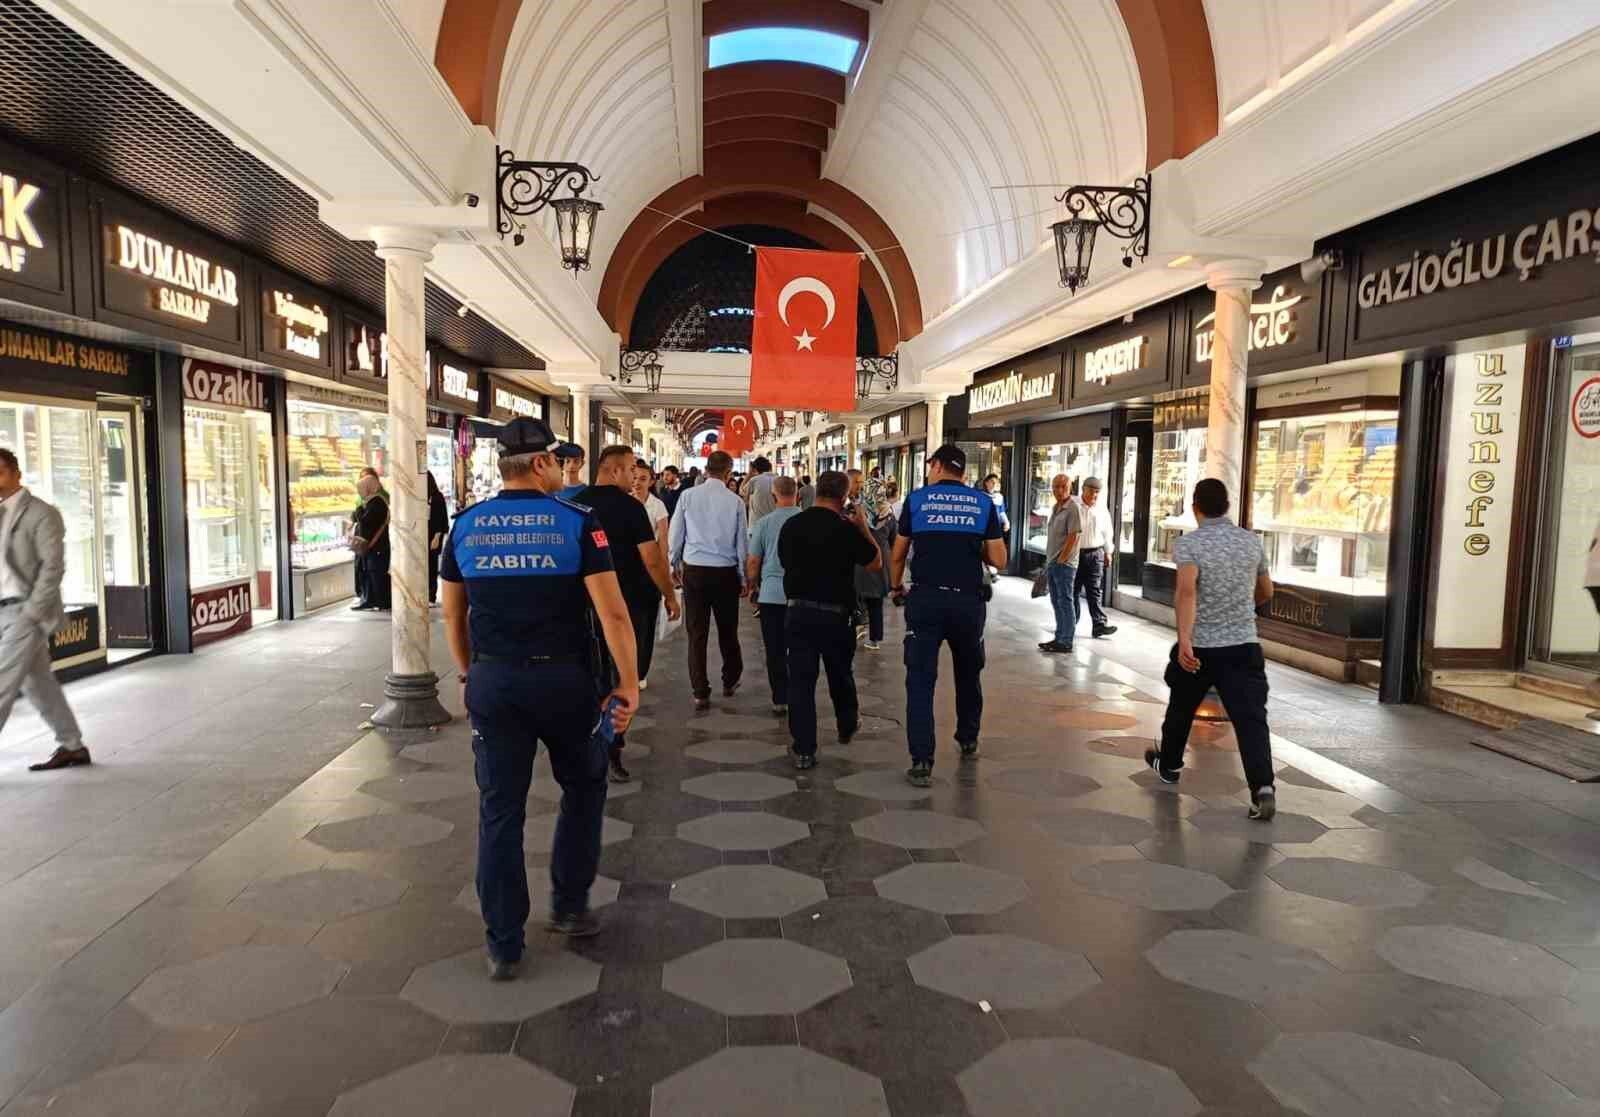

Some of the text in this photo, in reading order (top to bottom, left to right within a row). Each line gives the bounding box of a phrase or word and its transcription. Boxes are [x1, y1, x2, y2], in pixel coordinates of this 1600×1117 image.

[0, 172, 44, 248] K
[117, 225, 239, 306] DUMANLAR
[1358, 234, 1506, 309] GAZİOĞLU
[159, 287, 211, 323] SARRAF
[1084, 335, 1143, 386] BAŞKENT
[1464, 352, 1507, 556] uzunefe
[474, 514, 556, 528] KAYSERİ
[928, 514, 976, 525] ZABITA
[475, 554, 558, 569] ZABITA
